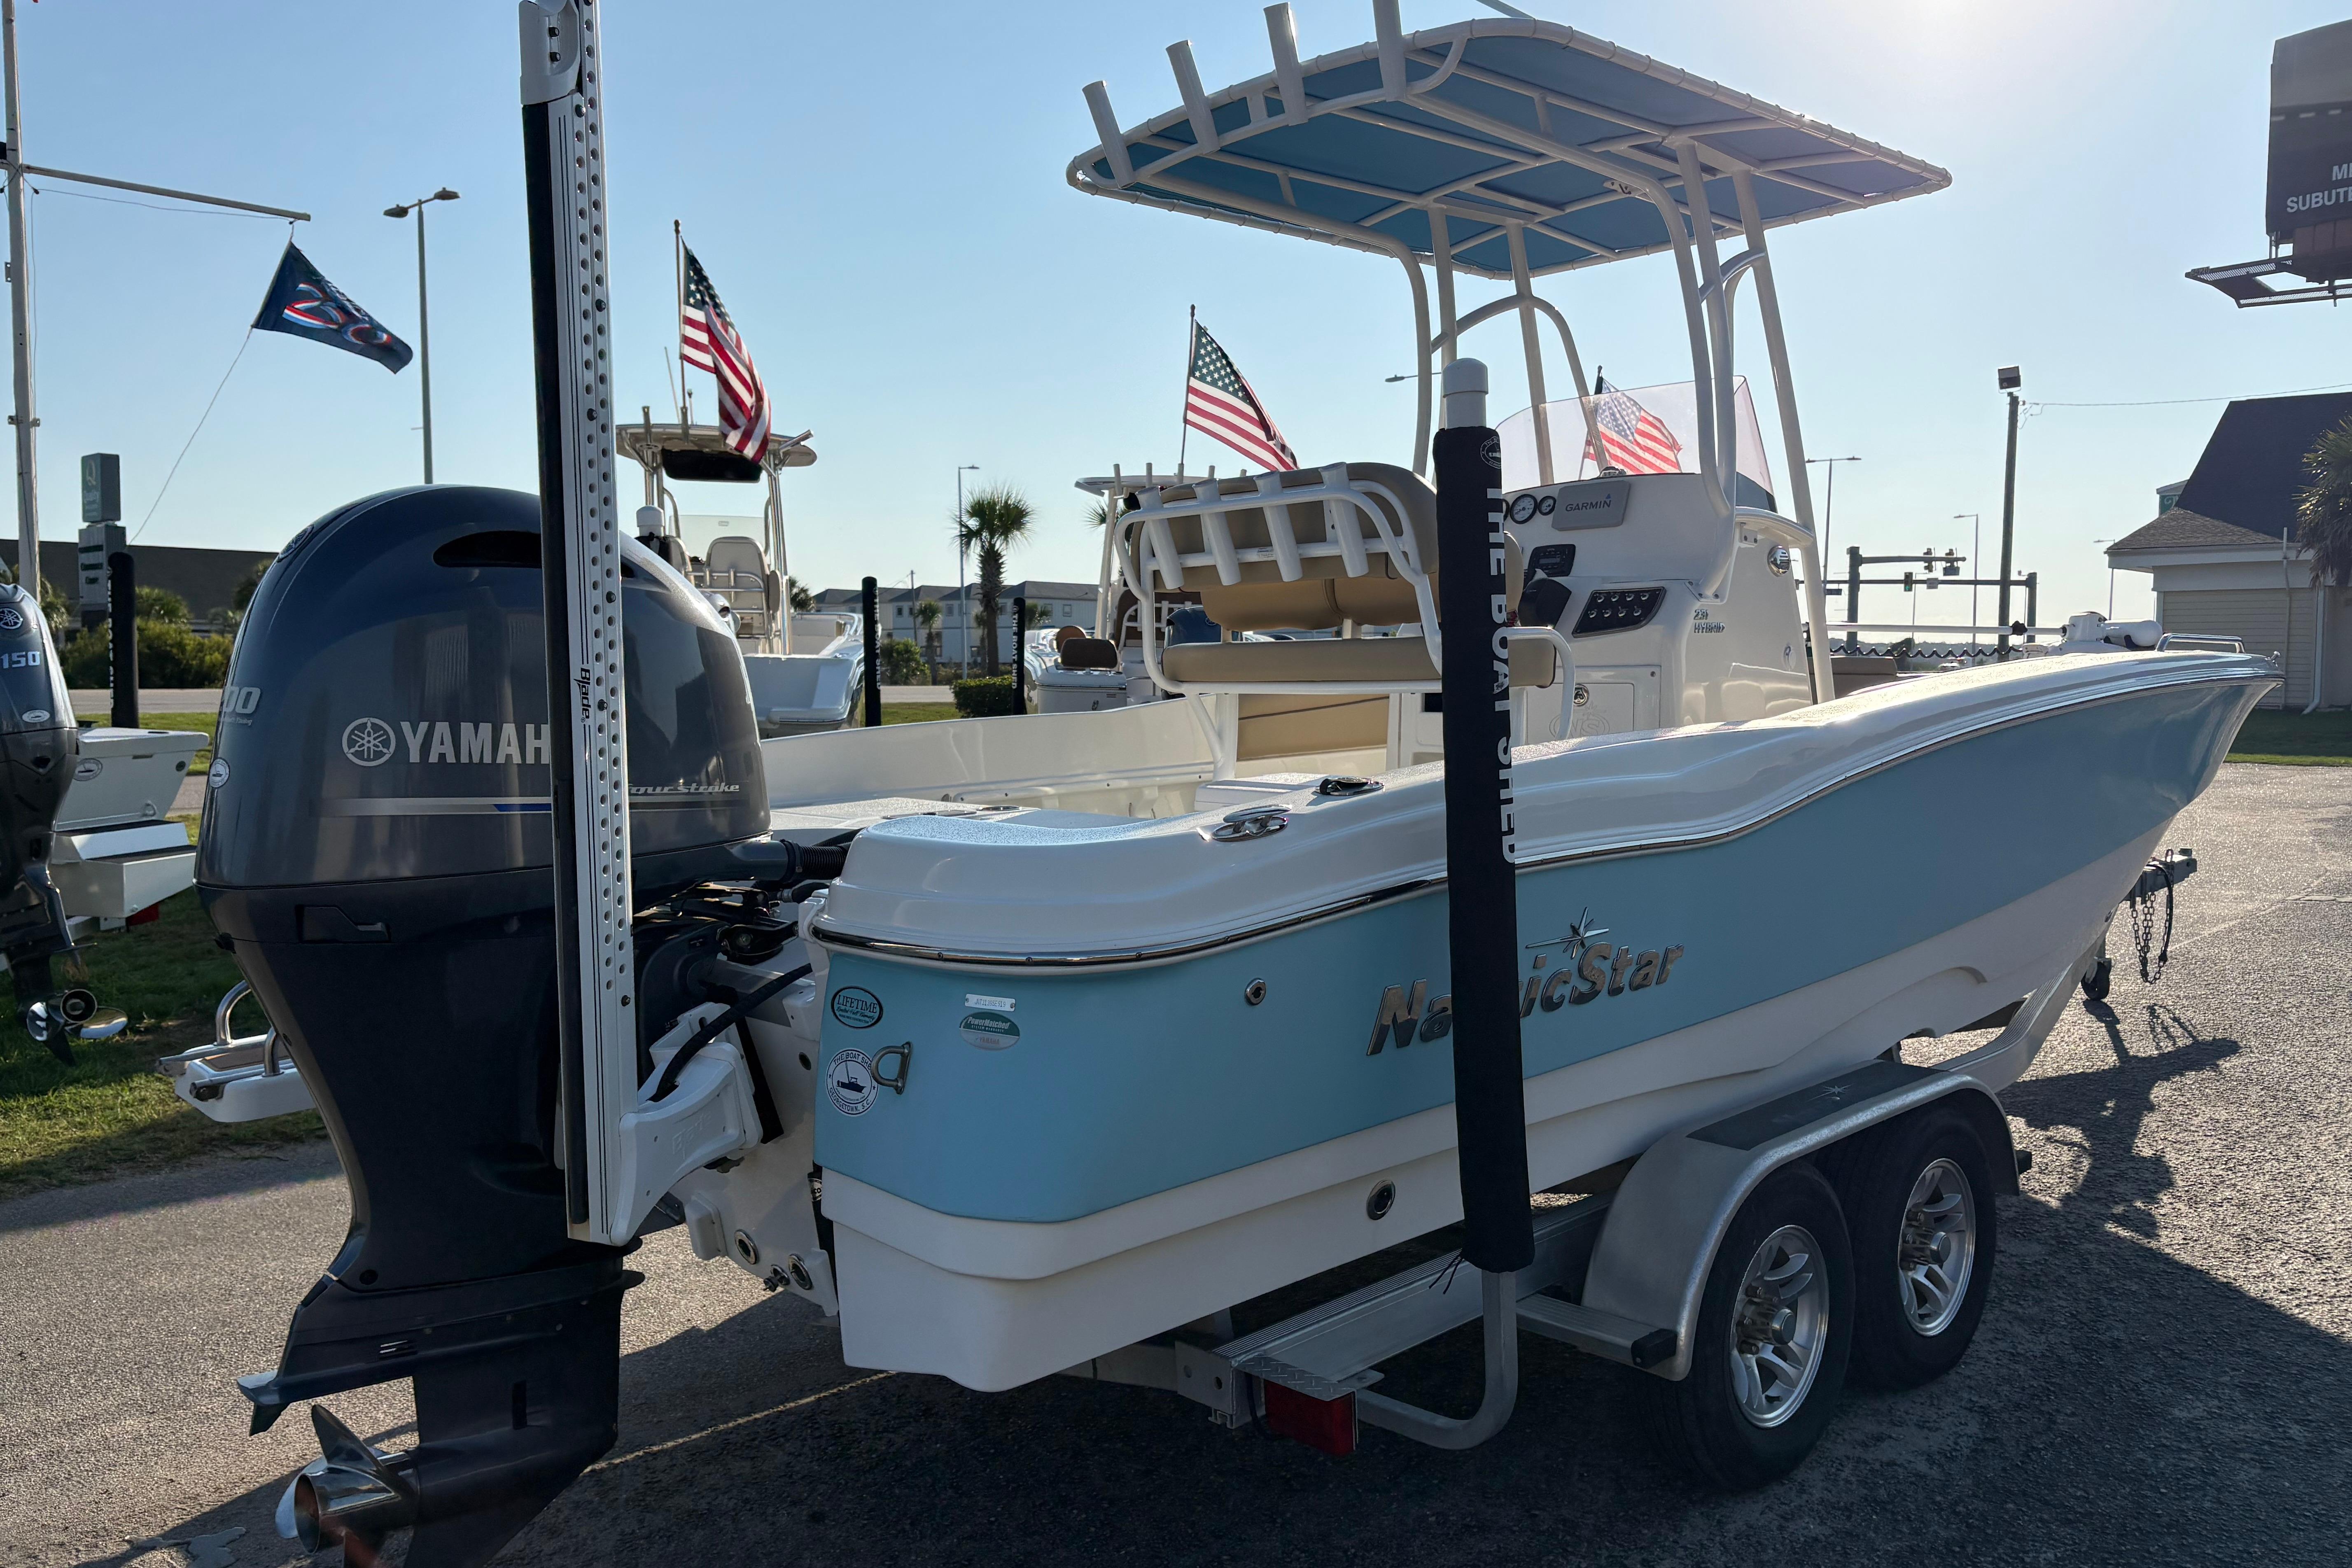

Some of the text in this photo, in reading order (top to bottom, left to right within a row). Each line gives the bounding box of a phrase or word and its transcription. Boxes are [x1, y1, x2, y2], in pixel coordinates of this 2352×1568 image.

[1565, 500, 1611, 511] GARMIN
[1, 651, 40, 669] 150
[400, 721, 551, 764] YAMAH
[837, 994, 877, 1013] LIFETIME
[1366, 942, 1685, 1056] NaicStar
[833, 1052, 871, 1070] THE BOAT SHE
